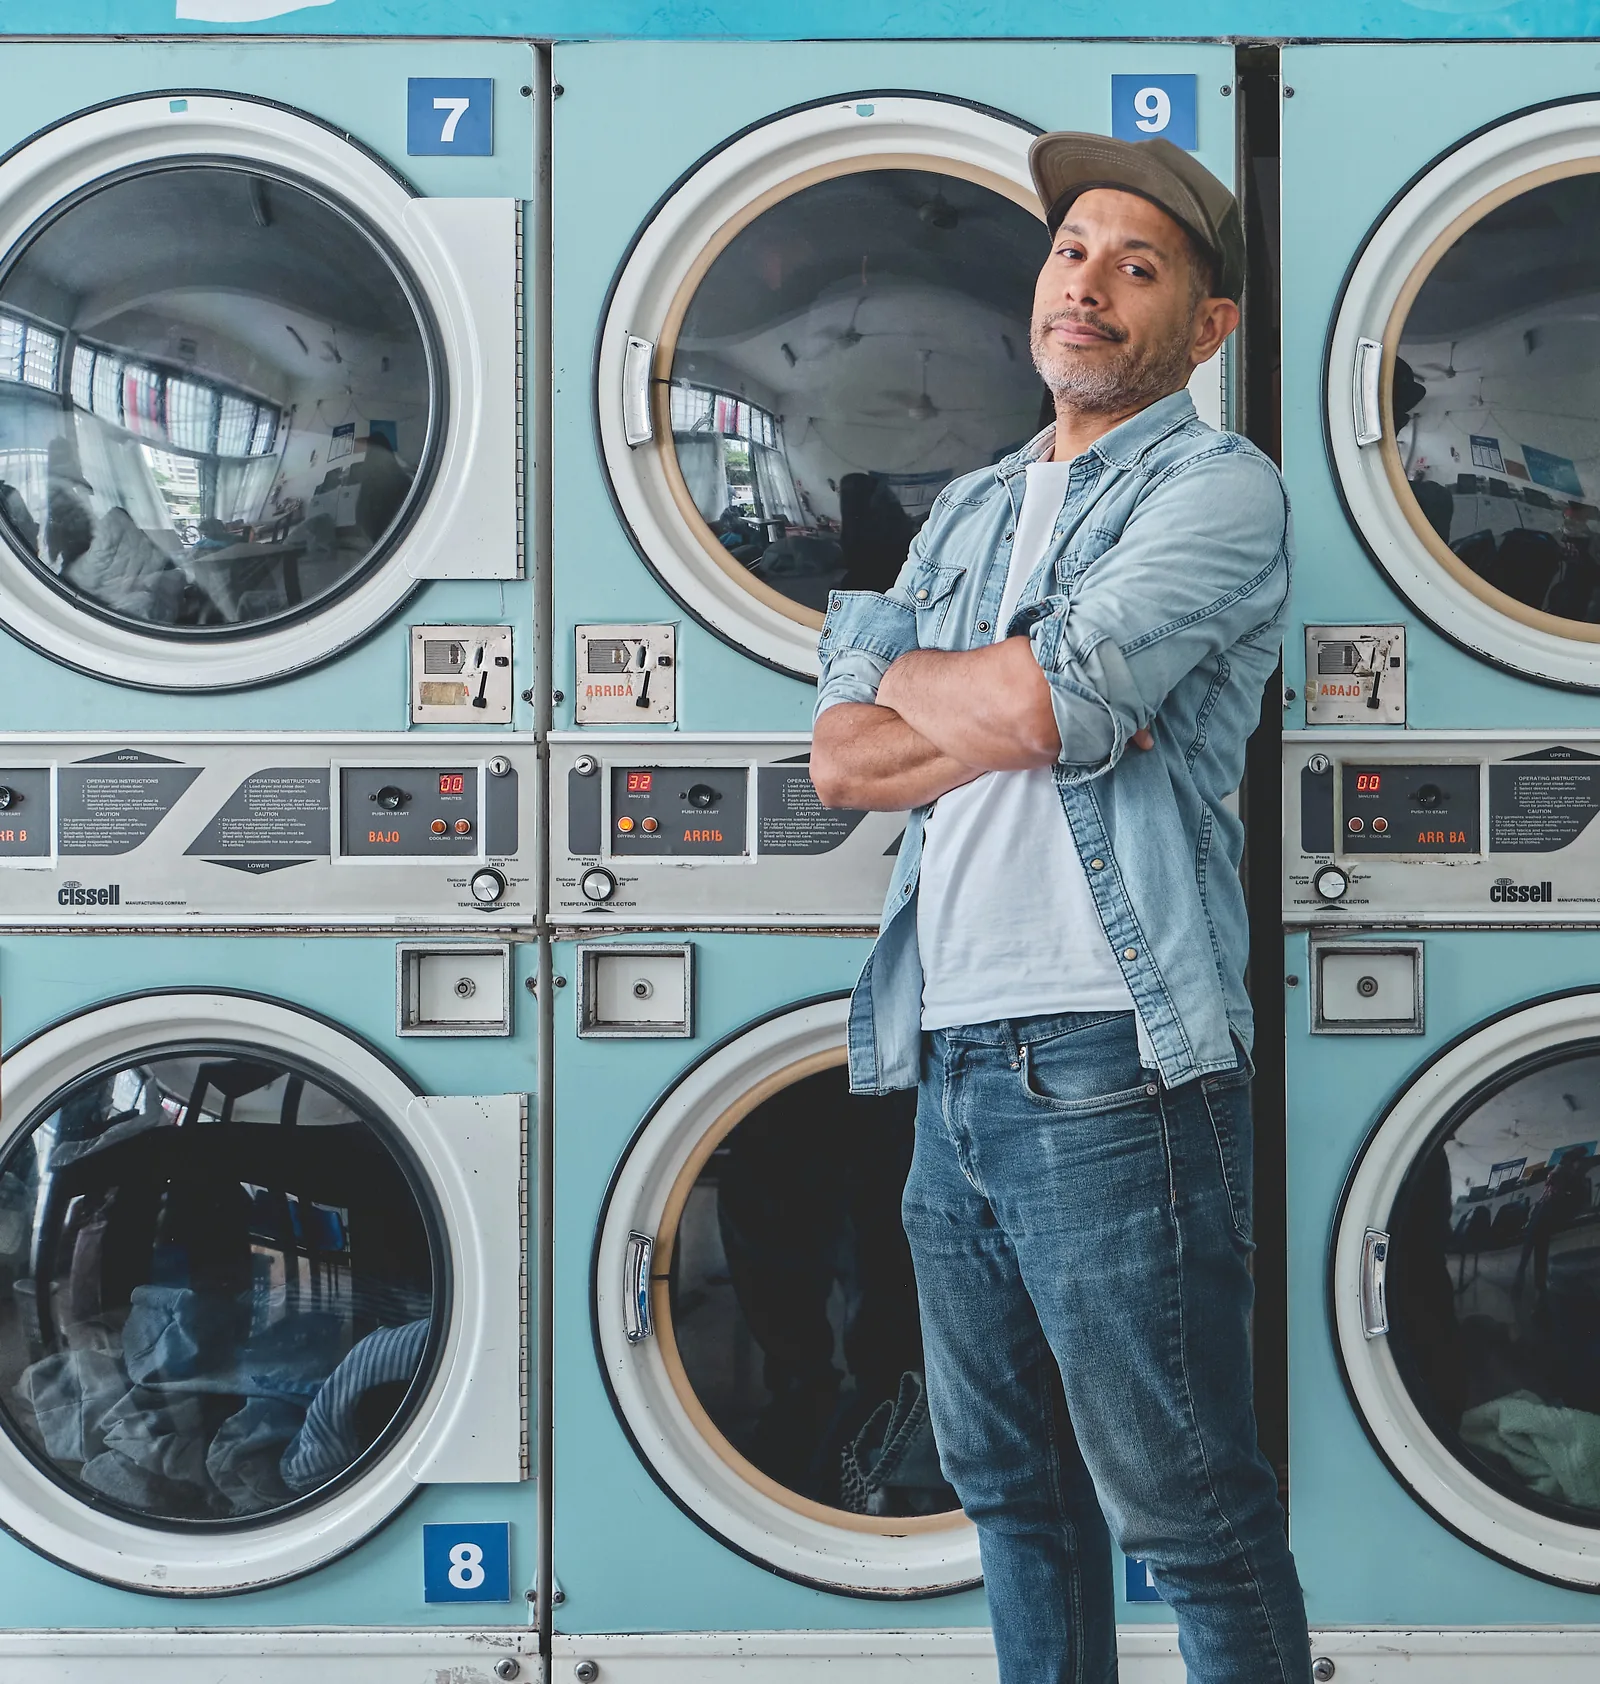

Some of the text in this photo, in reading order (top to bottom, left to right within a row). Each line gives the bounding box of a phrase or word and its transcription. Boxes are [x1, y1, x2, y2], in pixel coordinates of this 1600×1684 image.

[1134, 87, 1171, 133] 9
[433, 97, 470, 142] 7
[585, 684, 633, 697] ARRIBA
[1320, 684, 1360, 697] ABAJO
[628, 775, 651, 789] 32
[1357, 775, 1380, 790] 00
[368, 830, 401, 843] BAJO
[58, 884, 120, 906] cissell
[1489, 881, 1552, 903] cissell
[448, 1542, 485, 1589] 8
